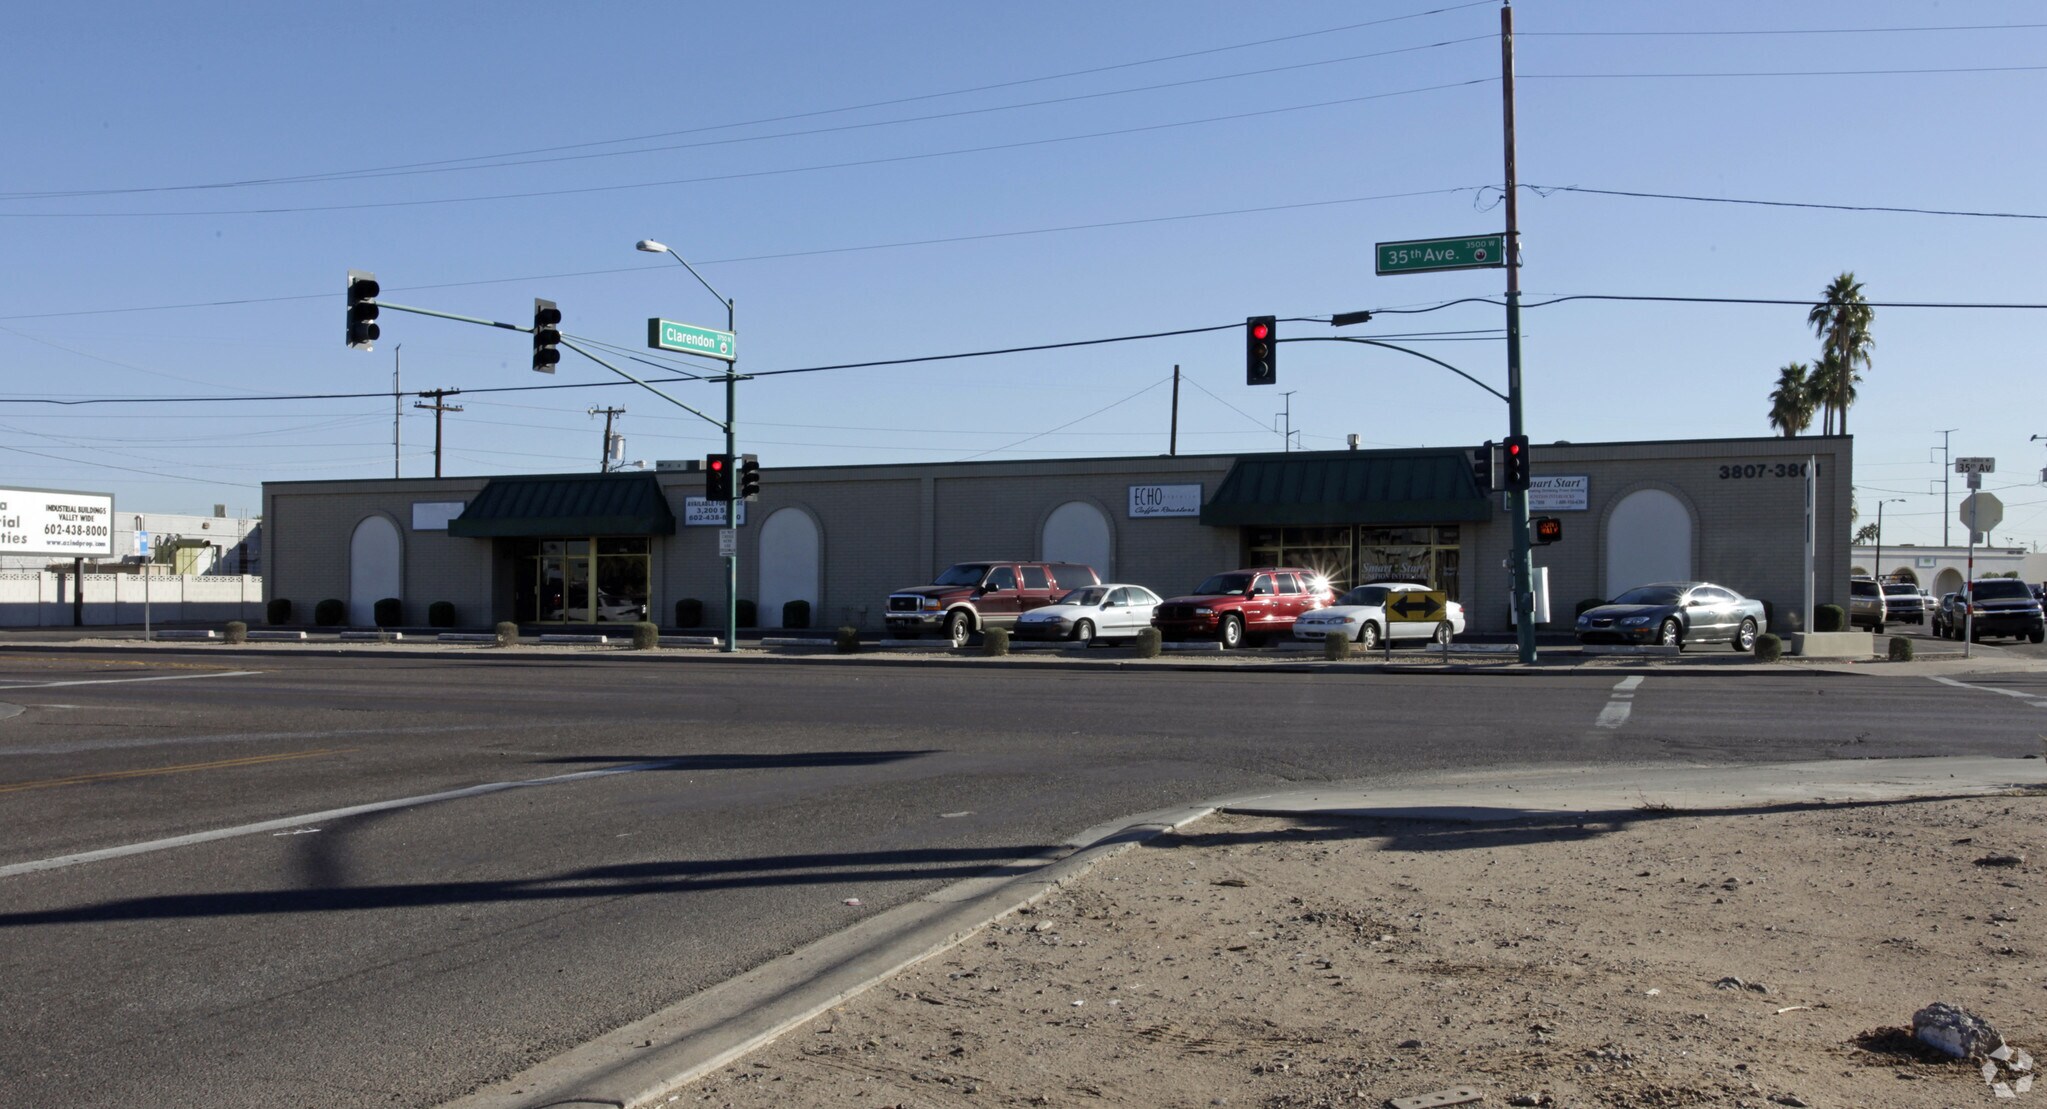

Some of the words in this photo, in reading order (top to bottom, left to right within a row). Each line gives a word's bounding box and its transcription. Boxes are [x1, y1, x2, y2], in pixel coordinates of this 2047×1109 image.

[1465, 240, 1486, 249] 3500
[1388, 249, 1422, 265] 35th
[1423, 247, 1460, 262] Ave.
[666, 327, 715, 349] Clarendon
[1529, 479, 1553, 488] mart
[1554, 477, 1581, 488] Start
[1134, 487, 1163, 506] ECHO
[45, 504, 77, 513] INDUSTRIAL
[78, 506, 107, 514] BUILDINGS
[1134, 506, 1160, 515] Coffee
[0, 515, 21, 528] ial
[58, 513, 79, 522] VALLEY
[80, 514, 95, 522] WIDE
[44, 523, 108, 537] 602-438-8000
[1361, 562, 1393, 573] Smart
[1399, 561, 1426, 573] Start
